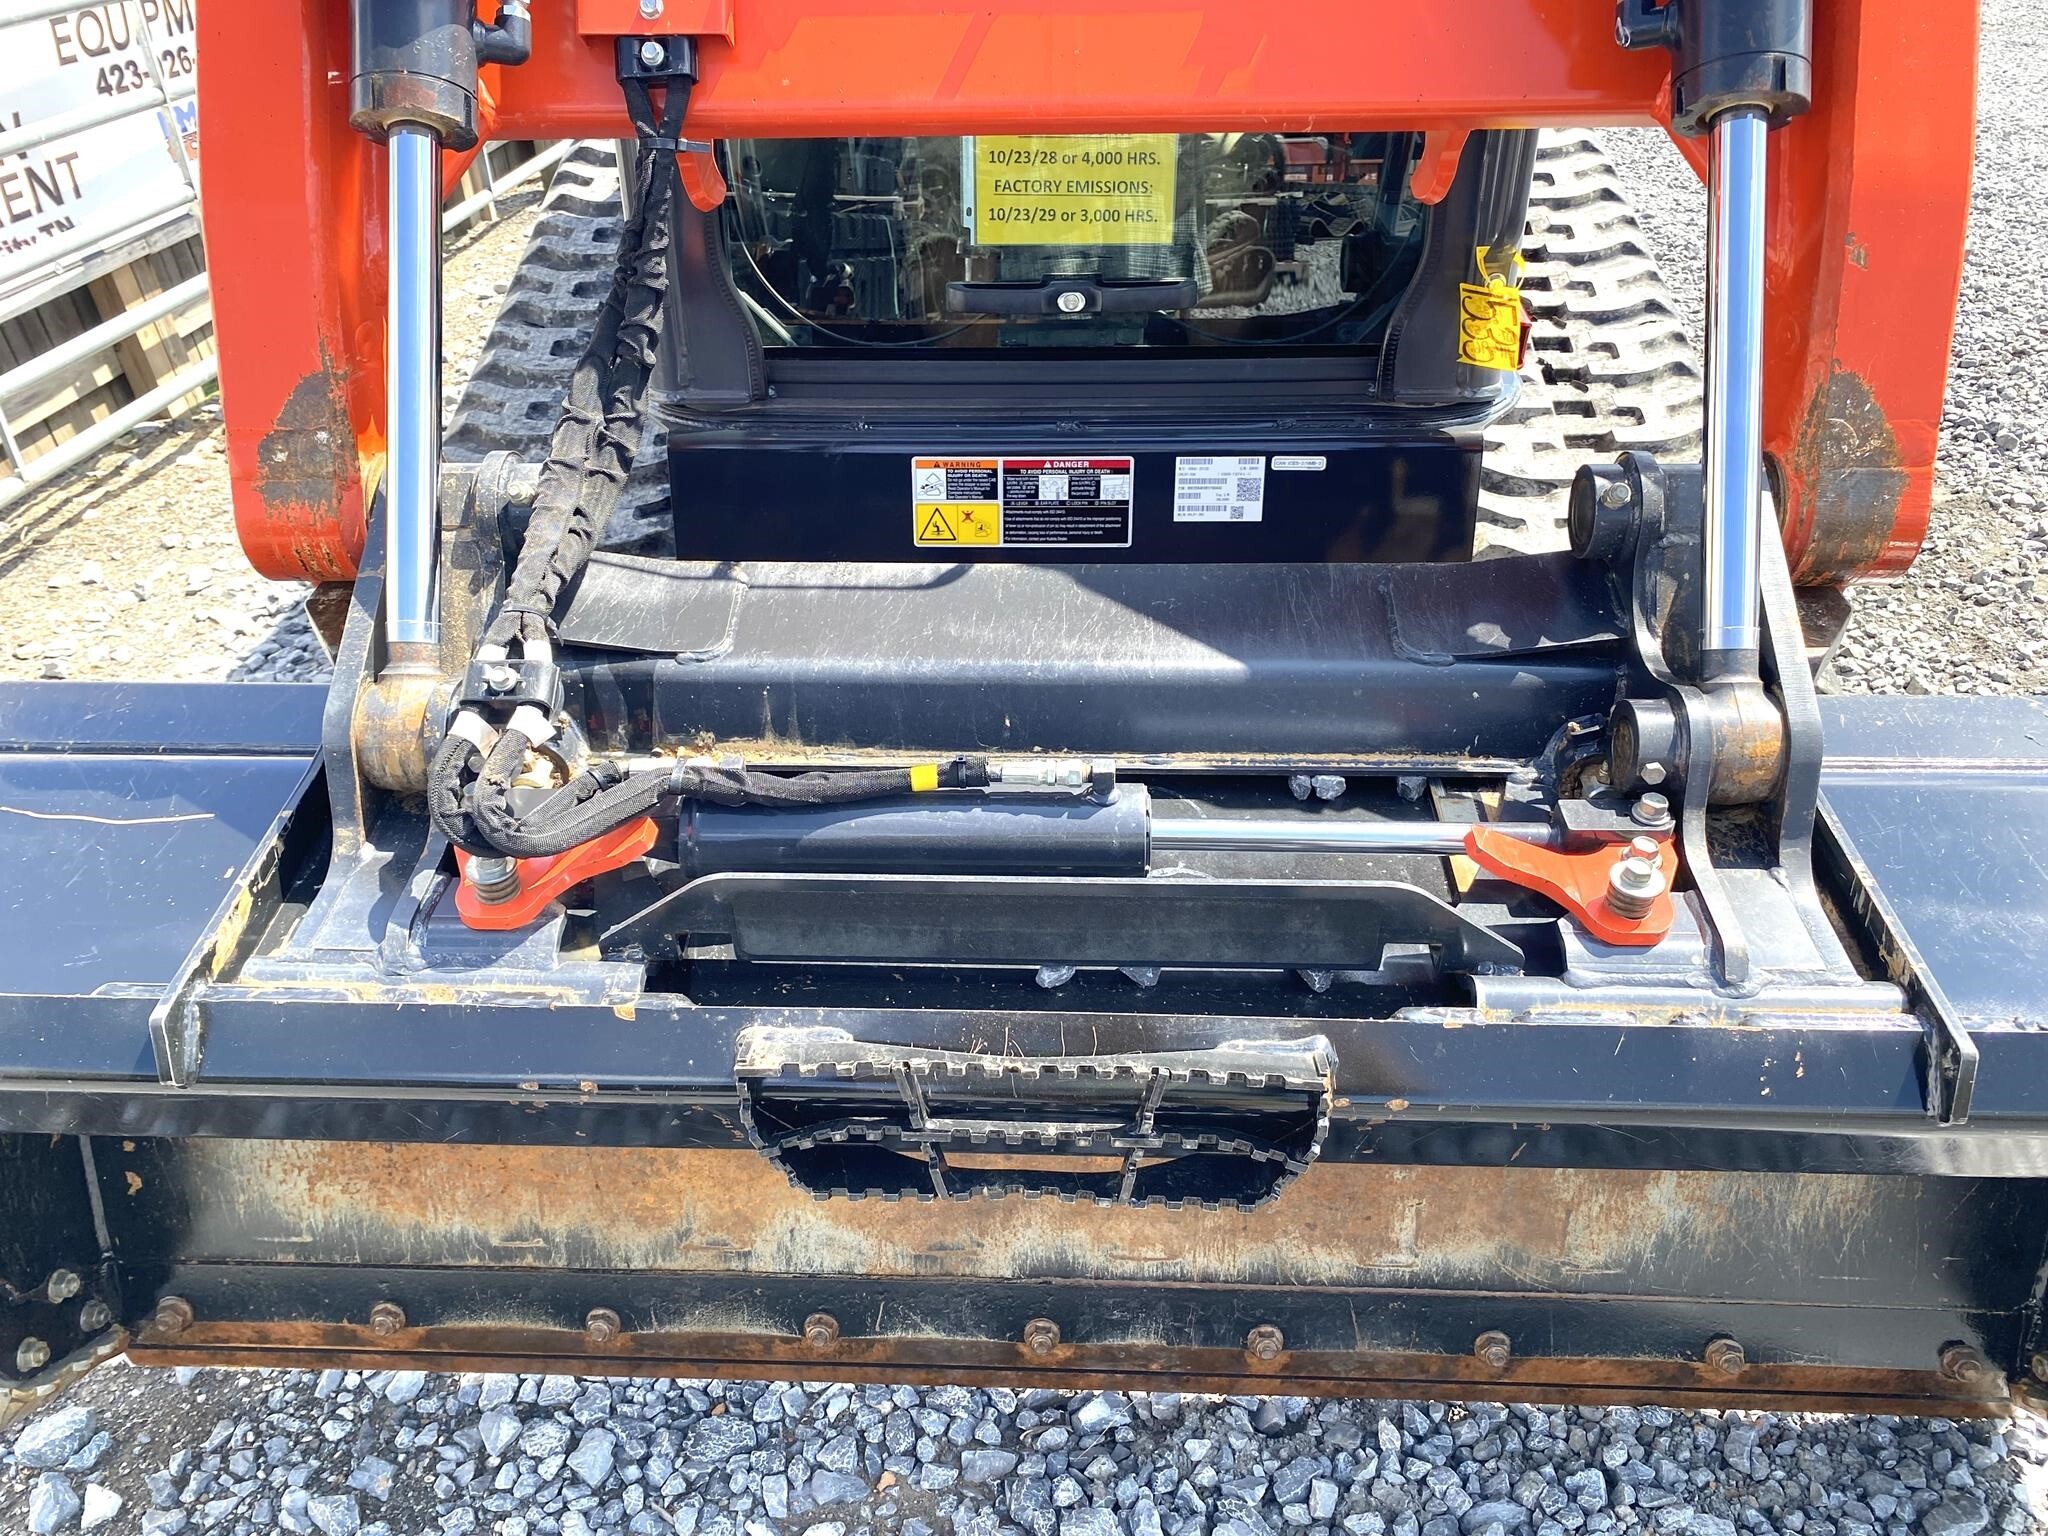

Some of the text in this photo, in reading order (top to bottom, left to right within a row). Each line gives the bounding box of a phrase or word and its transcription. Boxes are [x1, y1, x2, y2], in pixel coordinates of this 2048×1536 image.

[49, 0, 195, 66] EQUPM
[989, 150, 1160, 167] 10/23/28 or 4,000 HRS.
[994, 180, 1153, 194] FACTORY EMISSIONS:
[989, 207, 1158, 224] 10/23/29 or 3,000 HRS.
